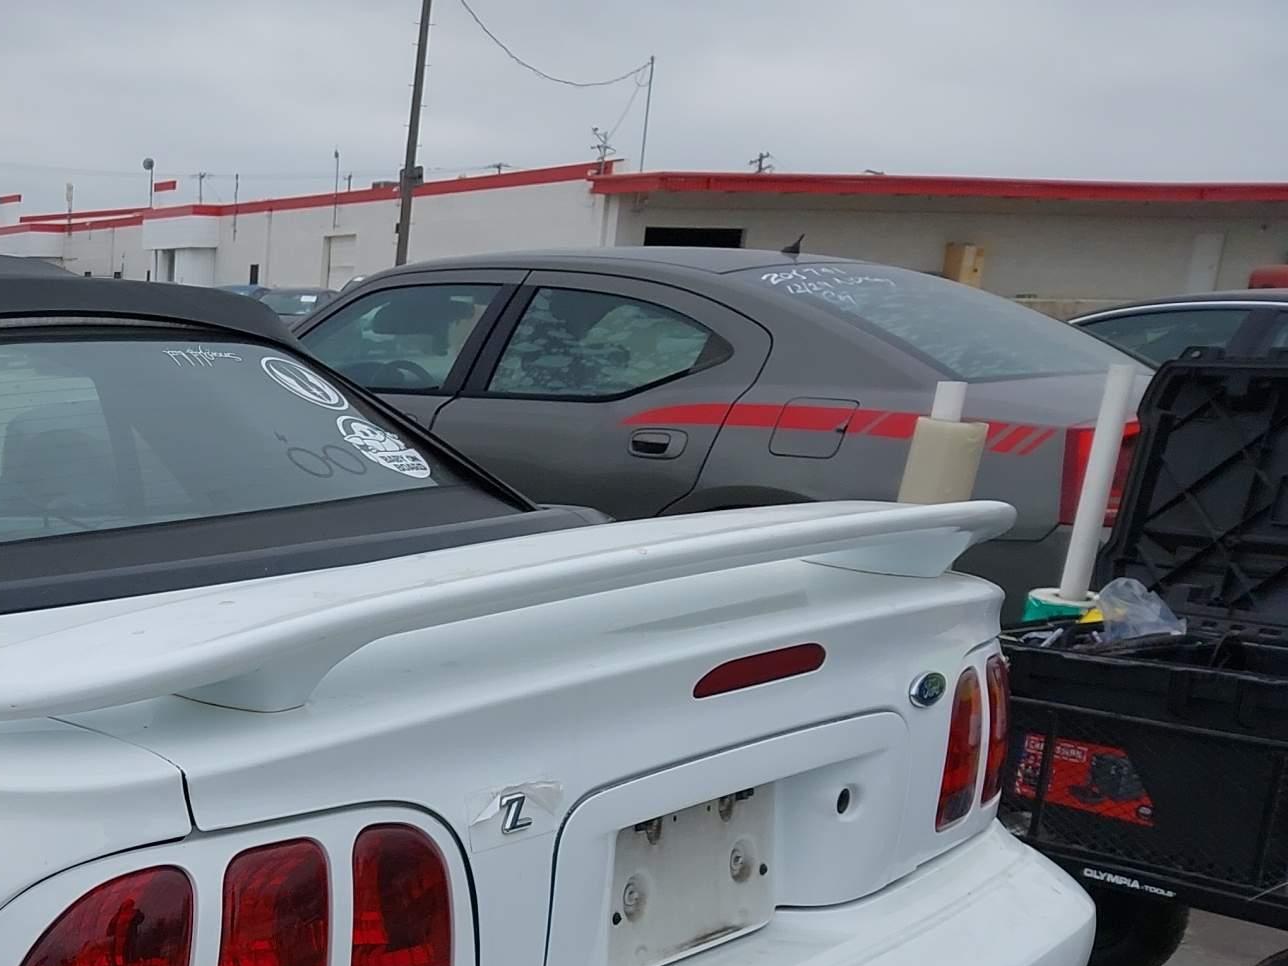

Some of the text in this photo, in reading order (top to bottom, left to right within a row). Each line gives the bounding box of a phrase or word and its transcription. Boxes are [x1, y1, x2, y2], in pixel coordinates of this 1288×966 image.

[500, 792, 533, 835] Z
[1083, 867, 1176, 898] OLYMPIA TOOLS
